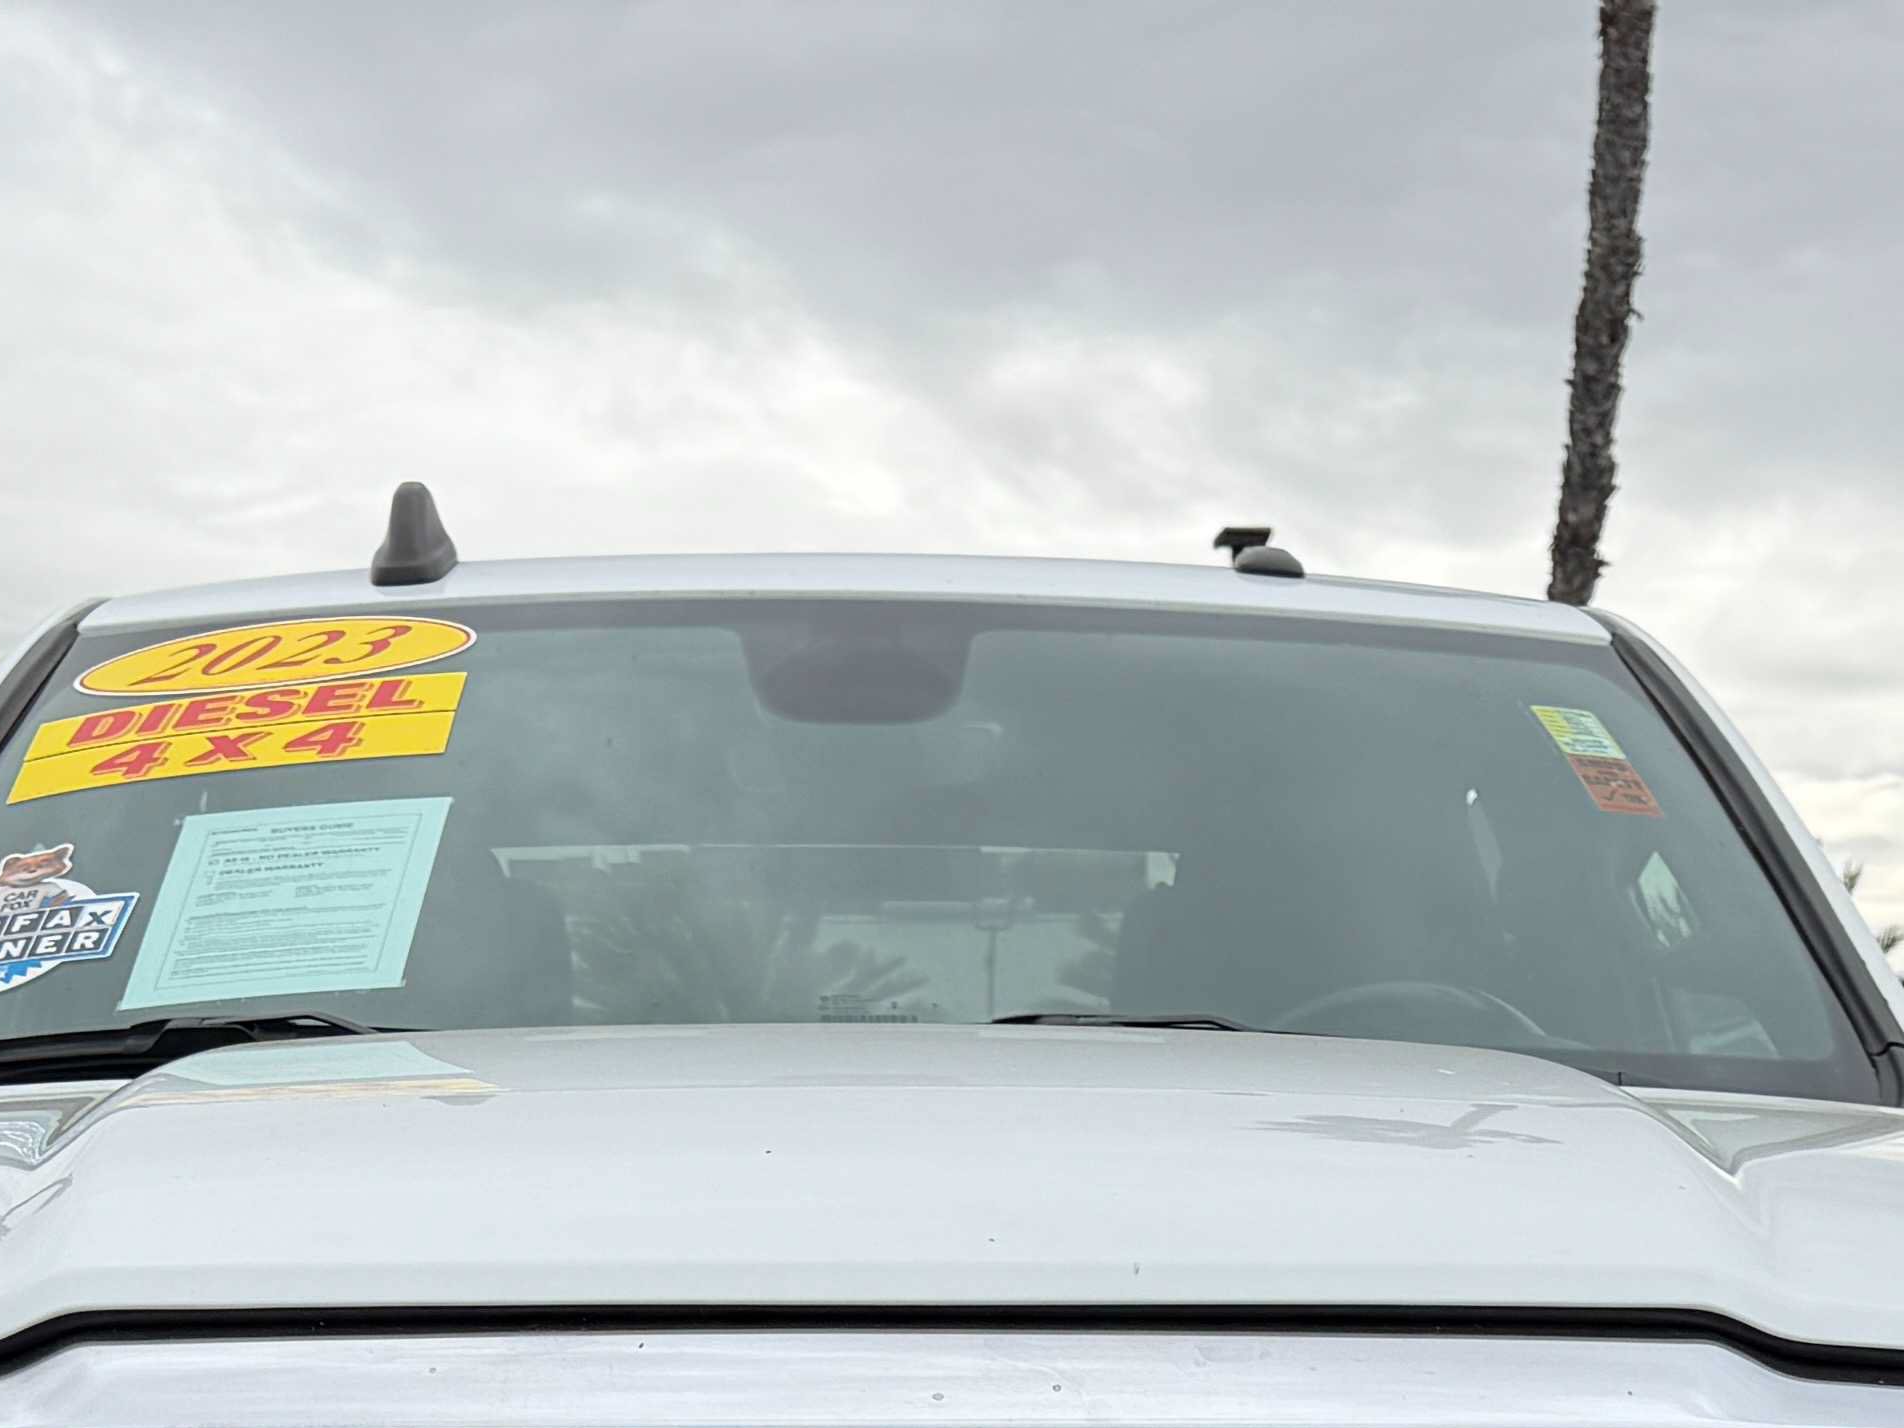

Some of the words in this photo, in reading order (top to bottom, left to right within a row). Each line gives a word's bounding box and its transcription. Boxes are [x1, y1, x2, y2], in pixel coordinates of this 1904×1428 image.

[129, 625, 412, 686] 2023
[66, 679, 424, 748] DIESEL
[0, 900, 33, 913] FOX
[3, 889, 39, 902] CAR
